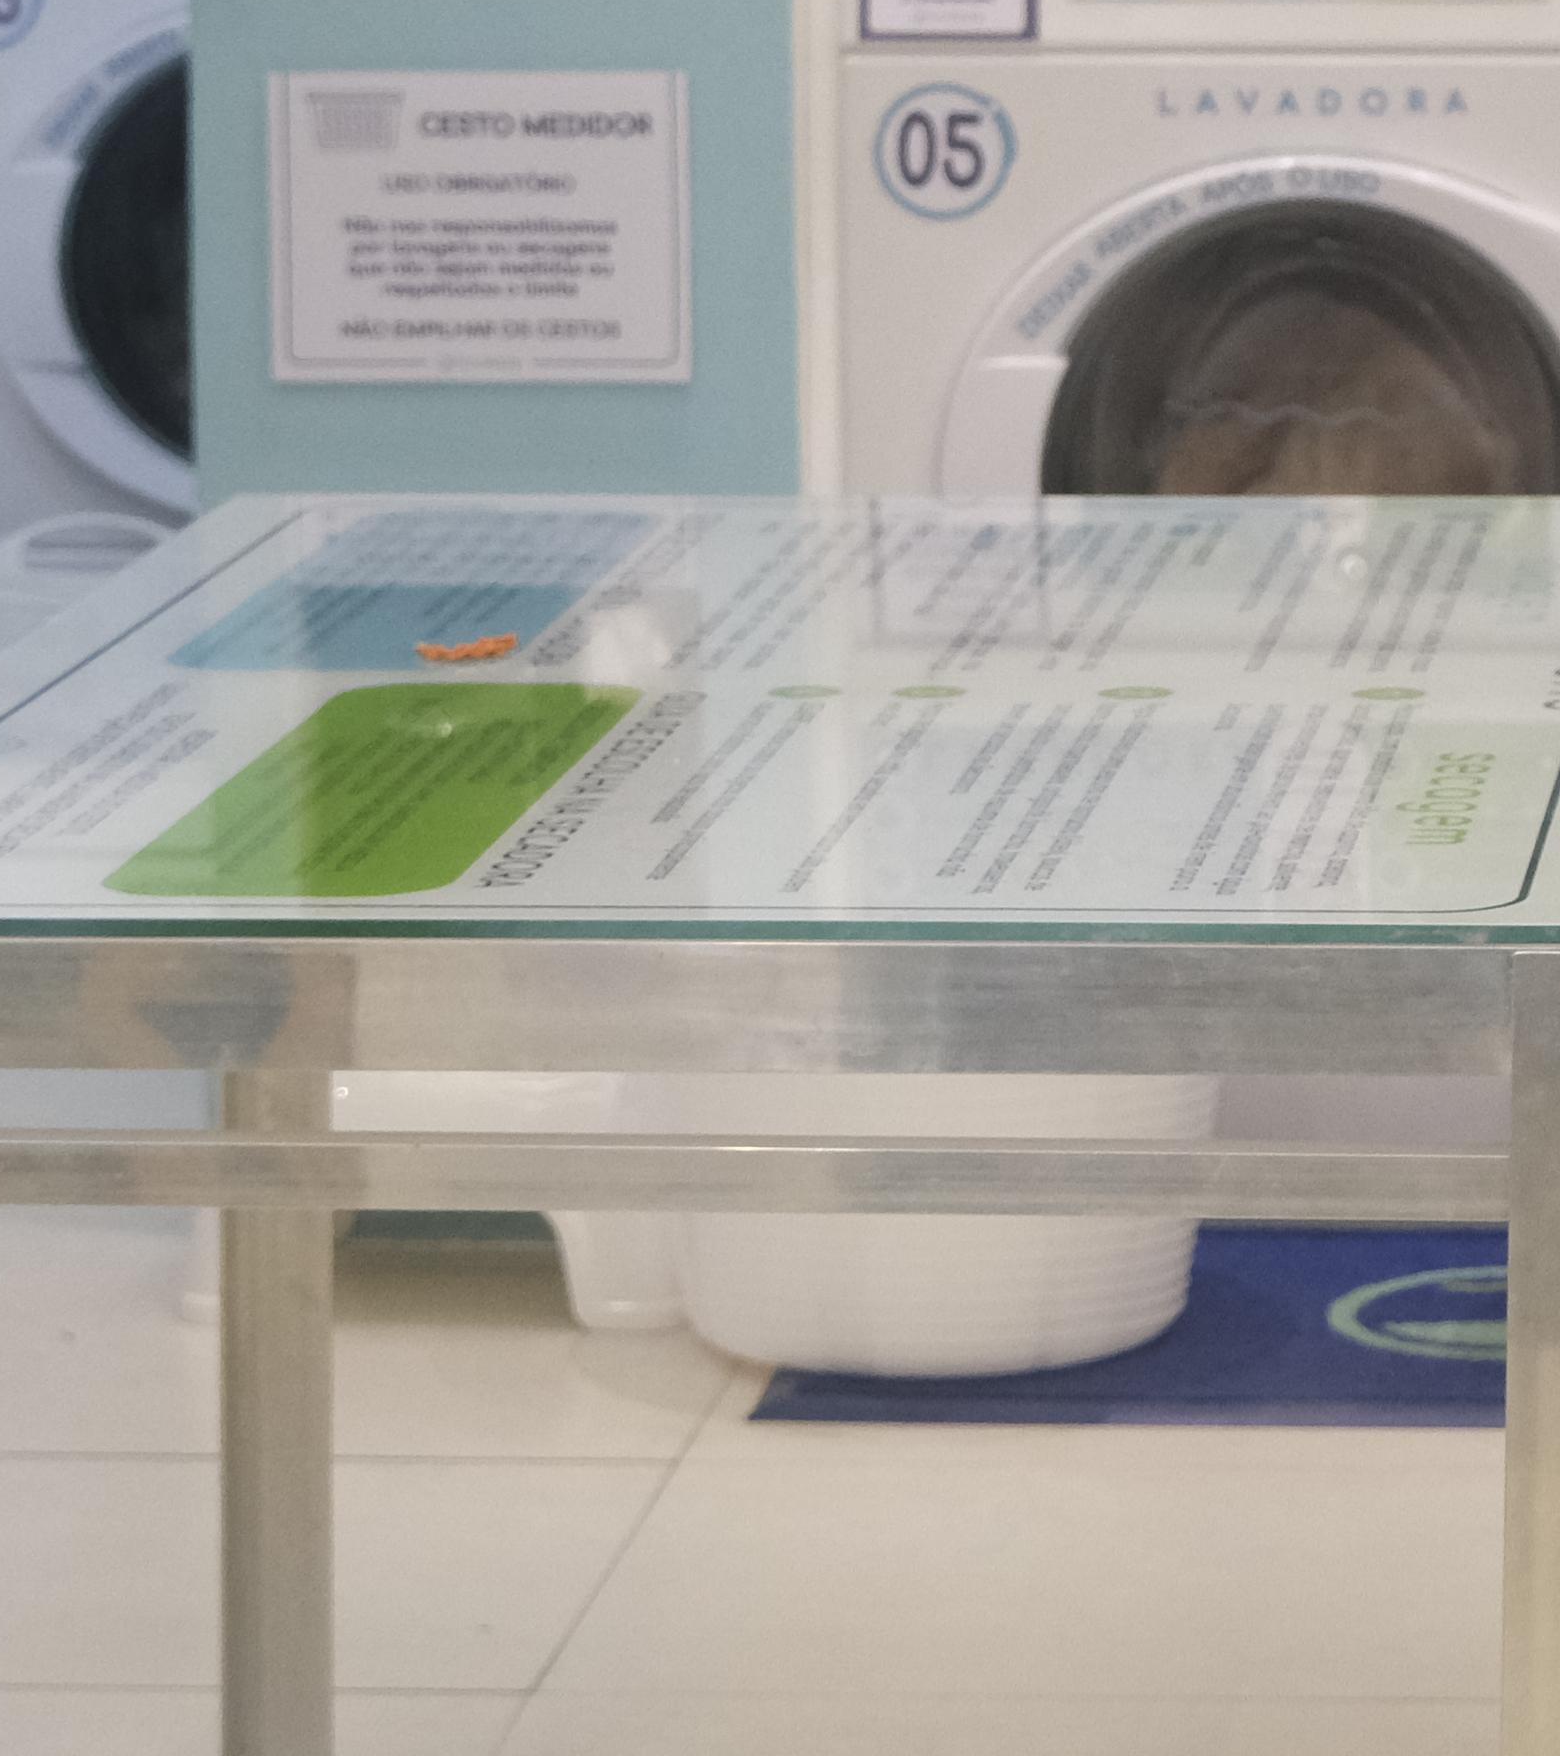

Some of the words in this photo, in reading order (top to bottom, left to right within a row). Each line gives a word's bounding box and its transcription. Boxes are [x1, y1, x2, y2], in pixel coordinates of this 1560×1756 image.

[419, 111, 516, 139] CESTO
[521, 111, 653, 139] MEDIDOR
[1156, 89, 1470, 116] LAVADORA
[898, 111, 985, 188] 05
[1394, 750, 1497, 846] secagem
[468, 817, 591, 888] SECADORA
